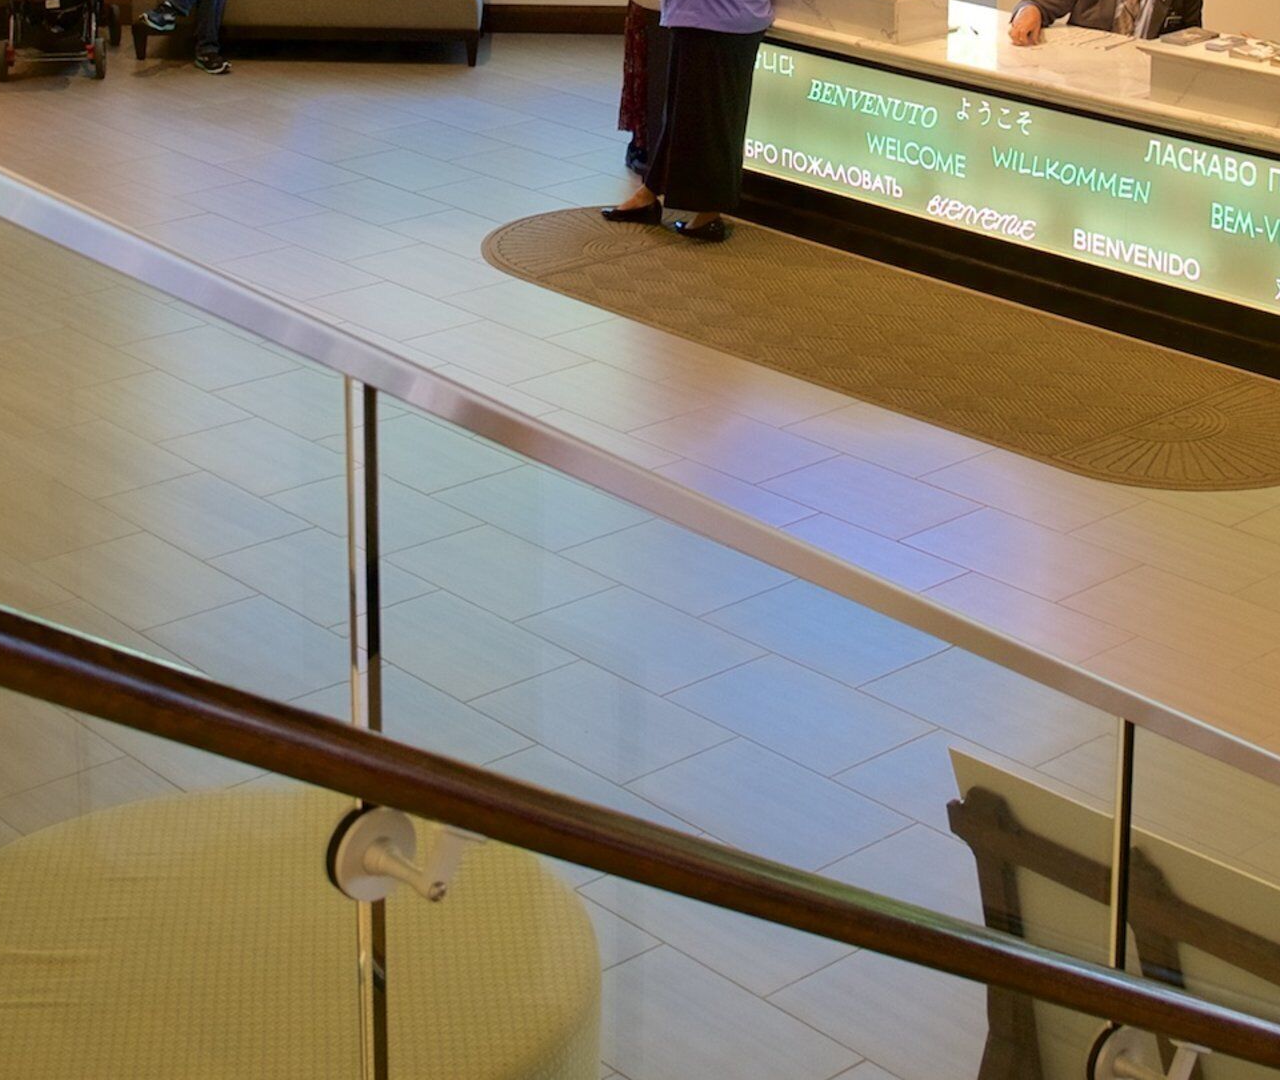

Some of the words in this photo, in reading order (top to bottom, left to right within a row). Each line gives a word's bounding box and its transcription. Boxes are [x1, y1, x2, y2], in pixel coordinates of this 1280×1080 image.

[808, 79, 938, 128] BENVENUTO
[956, 97, 1033, 136] ようこそ
[744, 139, 778, 164] БРО
[781, 148, 903, 198] ПОЖАЛОВАТЬ
[866, 132, 966, 178] WELCOME
[992, 146, 1152, 204] WILLKOMMEN
[1144, 140, 1257, 187] ЛАСКАВО
[1072, 228, 1200, 280] BIENVENIDO
